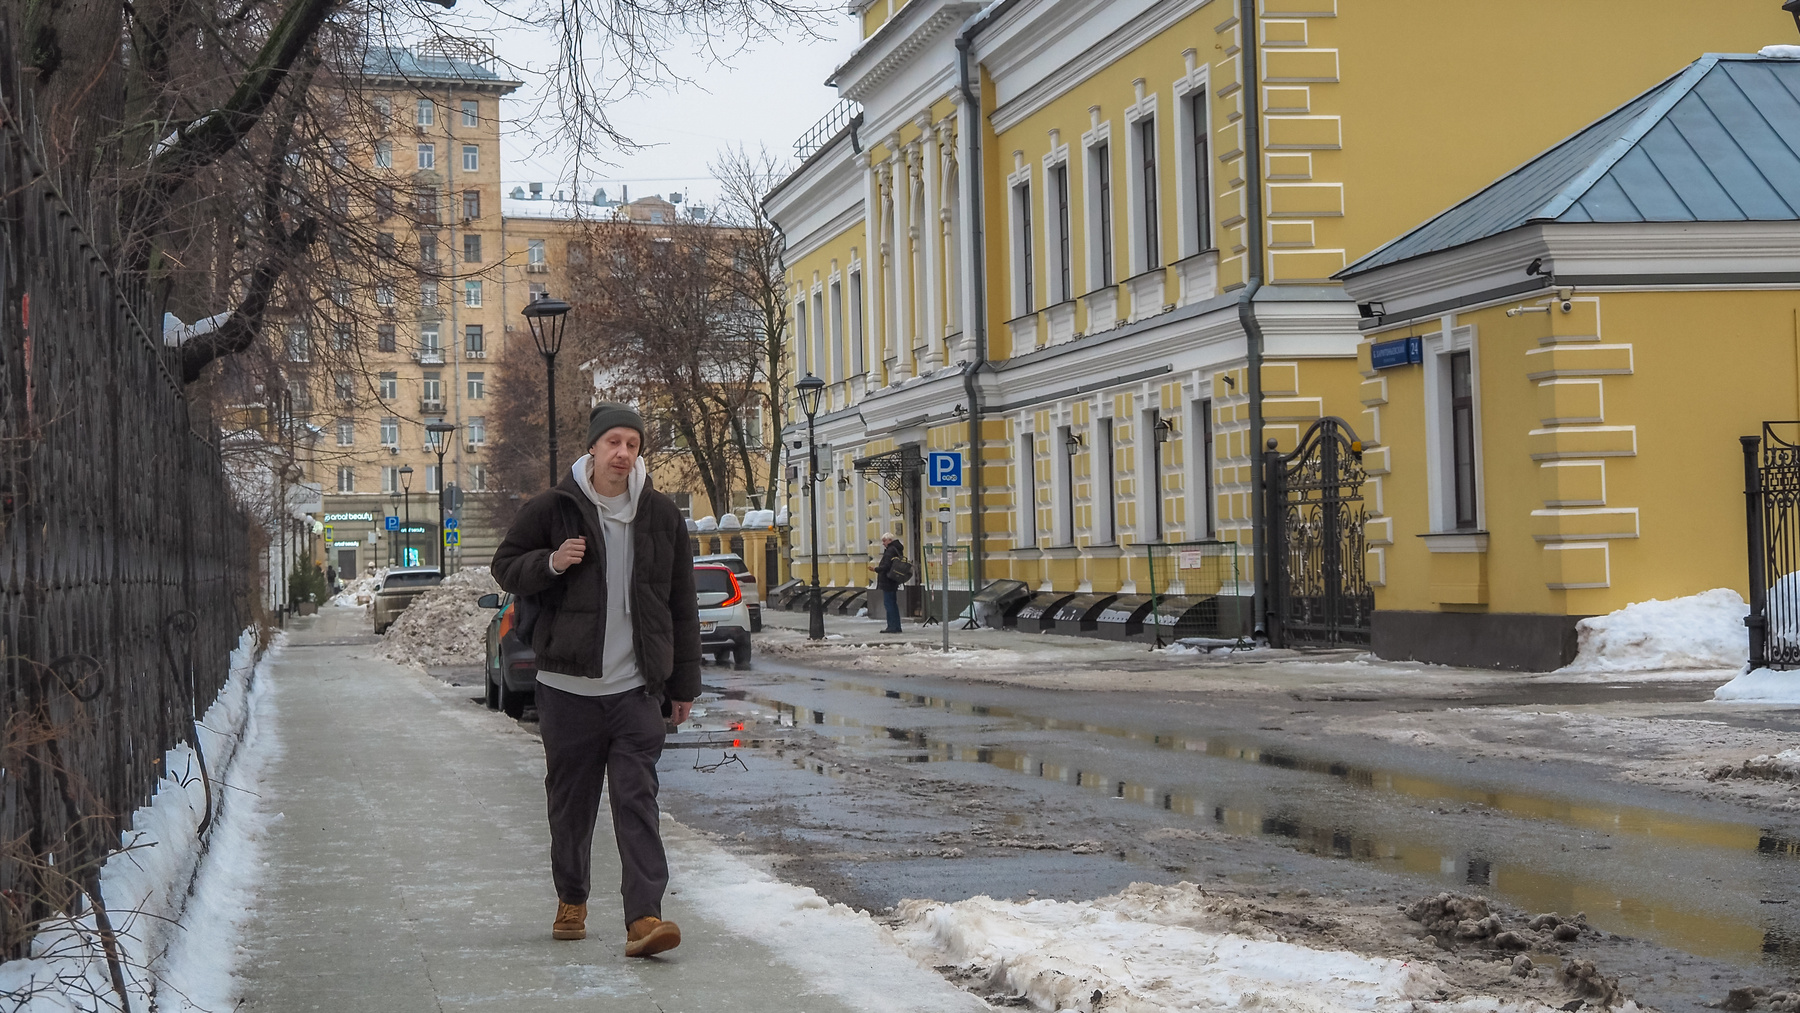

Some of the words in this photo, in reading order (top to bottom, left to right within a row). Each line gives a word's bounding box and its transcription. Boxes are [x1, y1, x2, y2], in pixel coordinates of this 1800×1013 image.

[1411, 342, 1419, 355] 24
[936, 455, 955, 482] P
[330, 512, 348, 521] arbat
[348, 511, 373, 522] beauty
[388, 517, 397, 529] P
